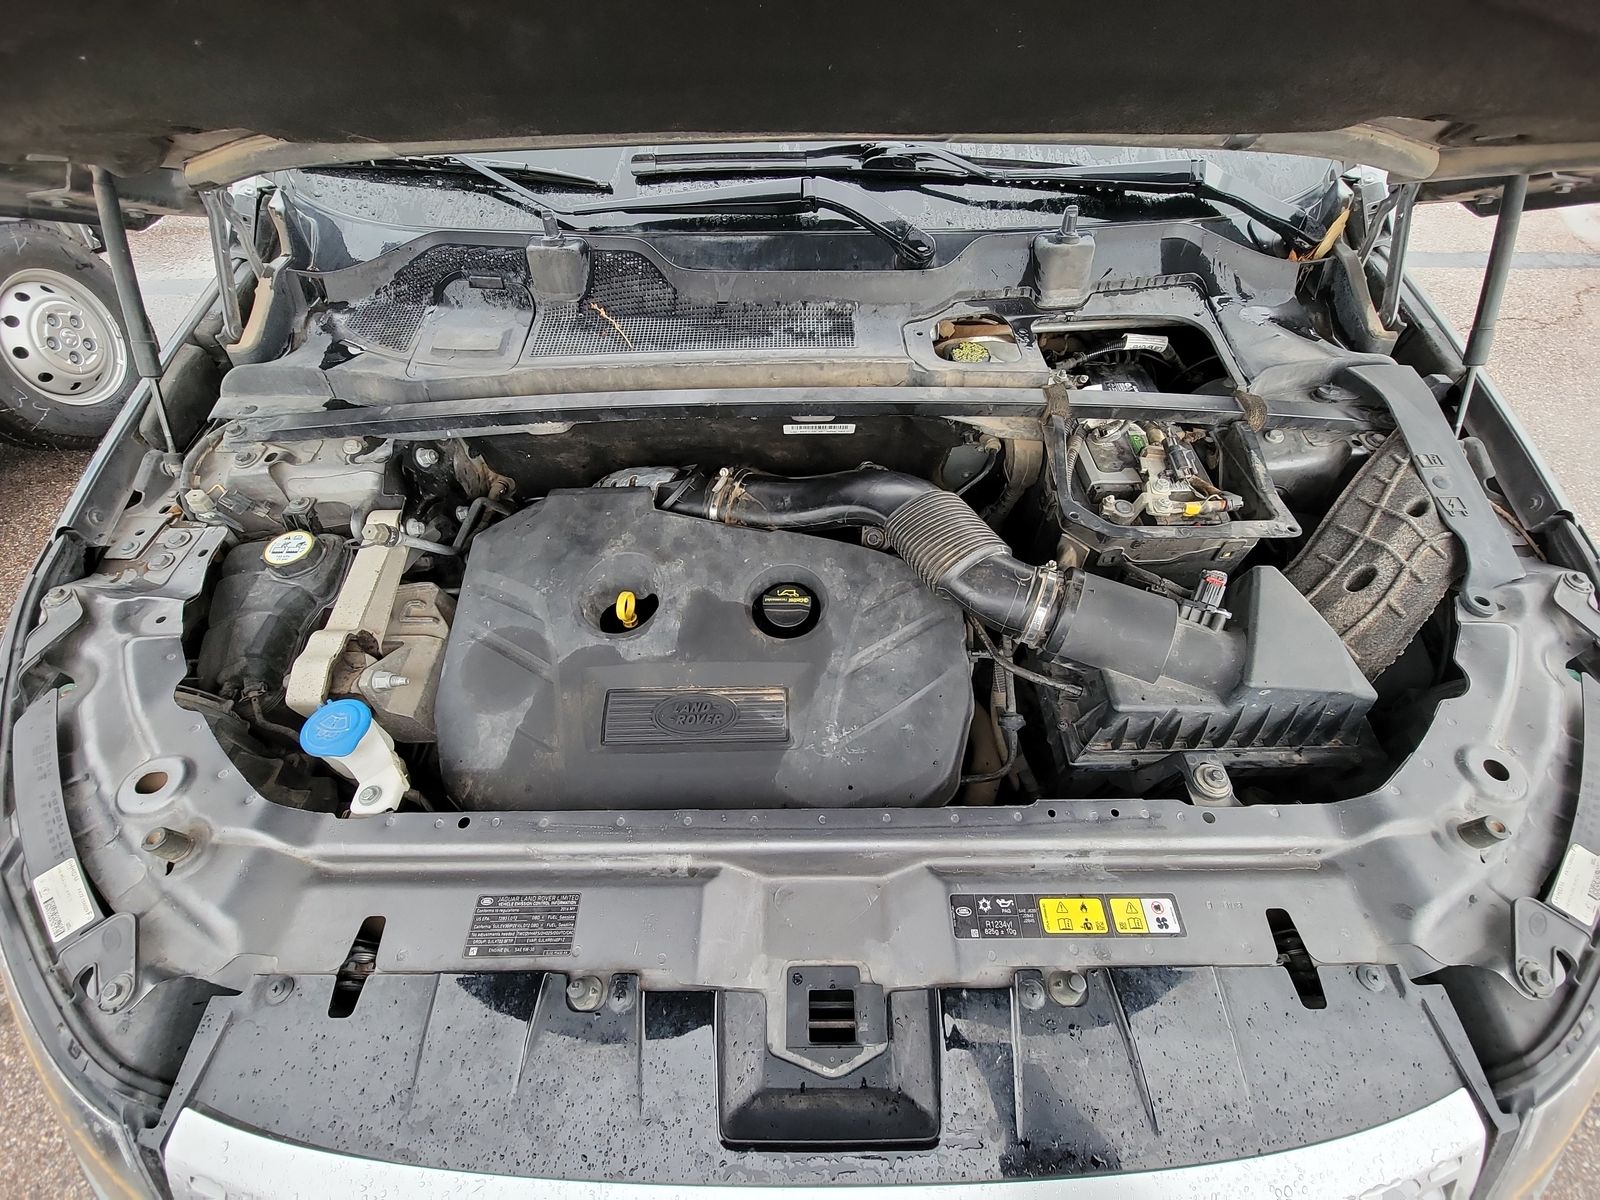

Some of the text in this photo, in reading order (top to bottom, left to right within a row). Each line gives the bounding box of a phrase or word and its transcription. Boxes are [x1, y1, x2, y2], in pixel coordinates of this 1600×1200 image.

[673, 701, 711, 713] LAND
[675, 713, 724, 726] ROVER
[984, 928, 1000, 936] 825g
[1006, 928, 1017, 936] 10g
